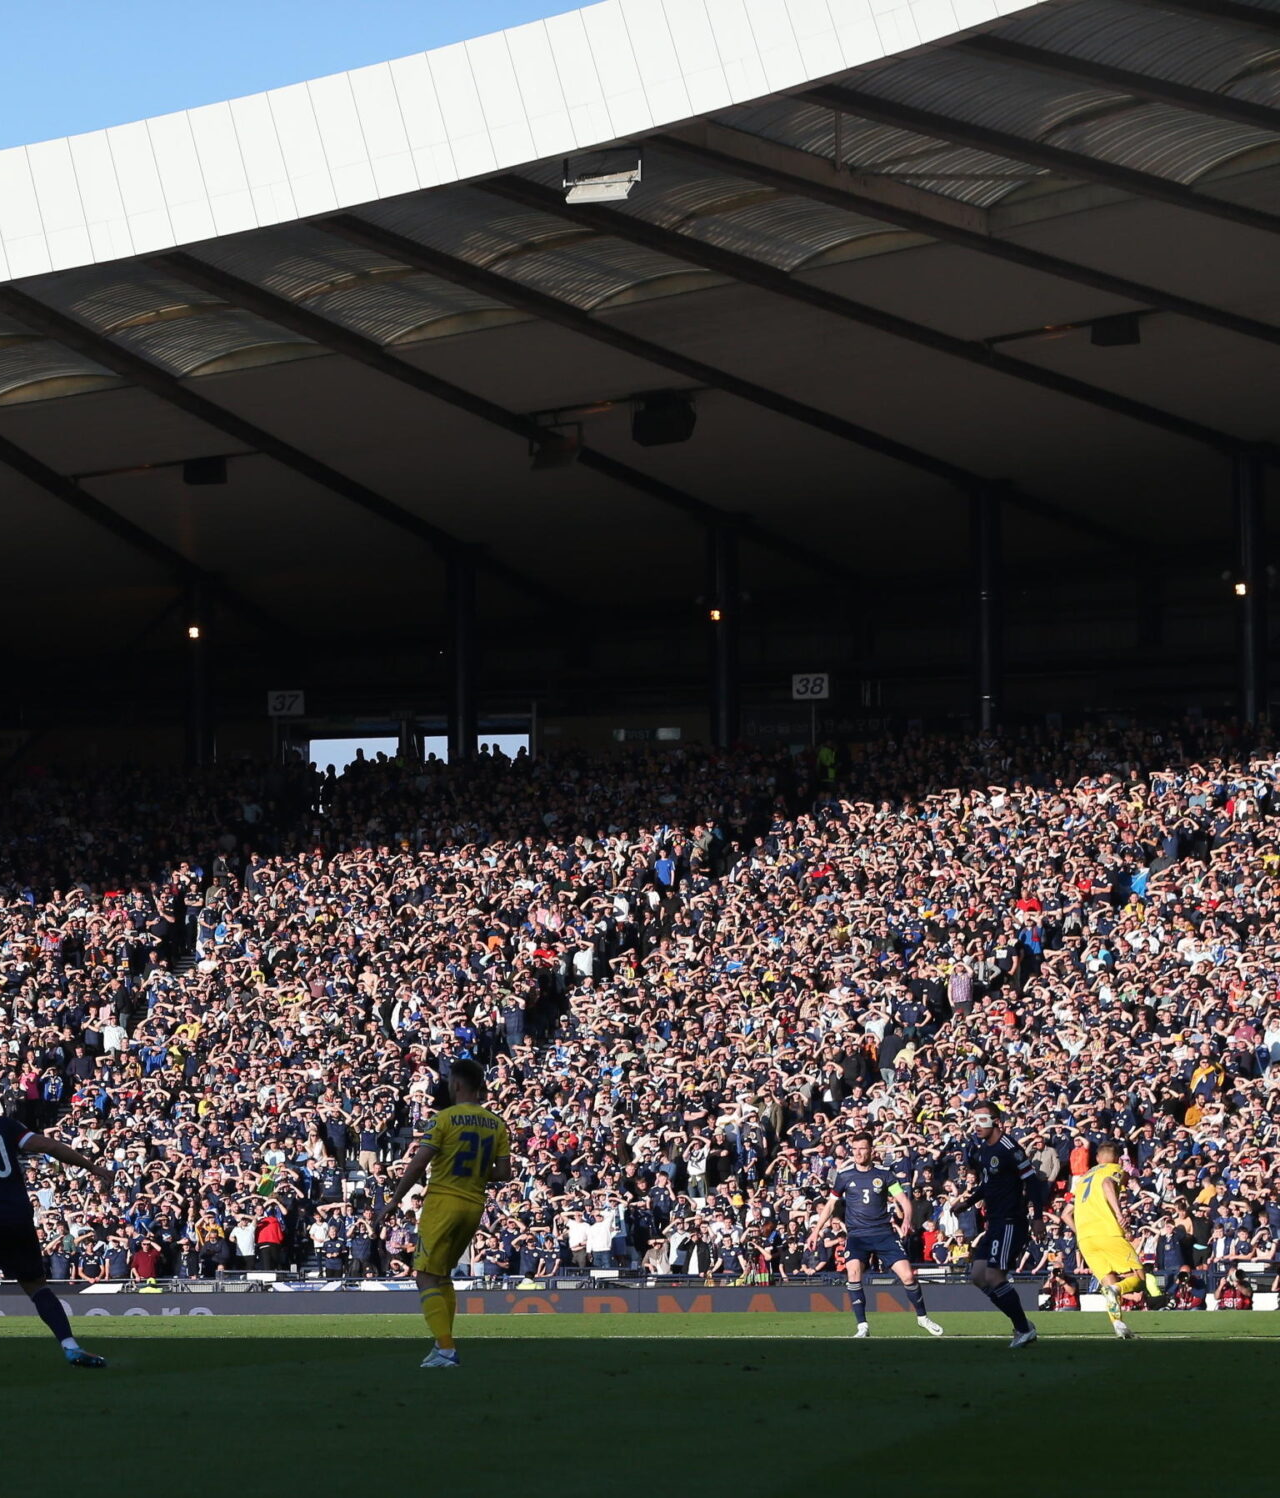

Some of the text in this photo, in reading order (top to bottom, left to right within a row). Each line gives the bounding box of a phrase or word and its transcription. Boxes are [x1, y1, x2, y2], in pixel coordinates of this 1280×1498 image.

[795, 676, 825, 696] 38
[272, 693, 302, 712] 37
[452, 1132, 495, 1177] 21
[862, 1189, 871, 1205] 3
[991, 1239, 1000, 1256] 8
